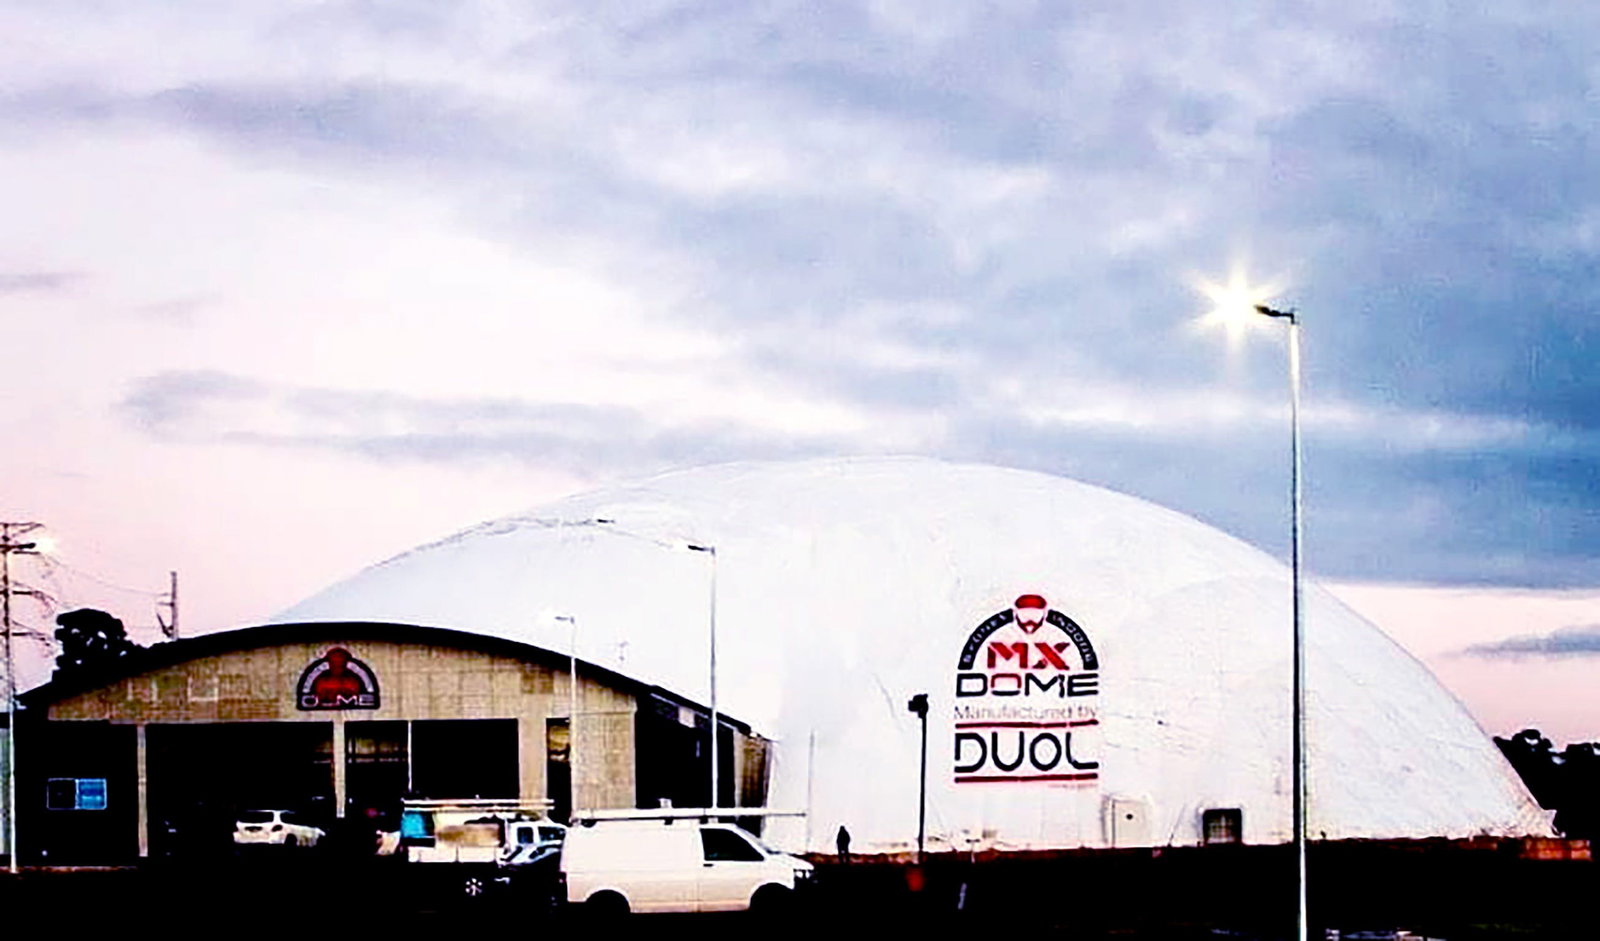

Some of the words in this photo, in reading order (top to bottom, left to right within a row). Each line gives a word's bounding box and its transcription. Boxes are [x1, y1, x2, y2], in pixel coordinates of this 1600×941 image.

[987, 642, 1070, 670] MX
[956, 673, 1099, 698] DOME
[954, 731, 1099, 773] DUOL
